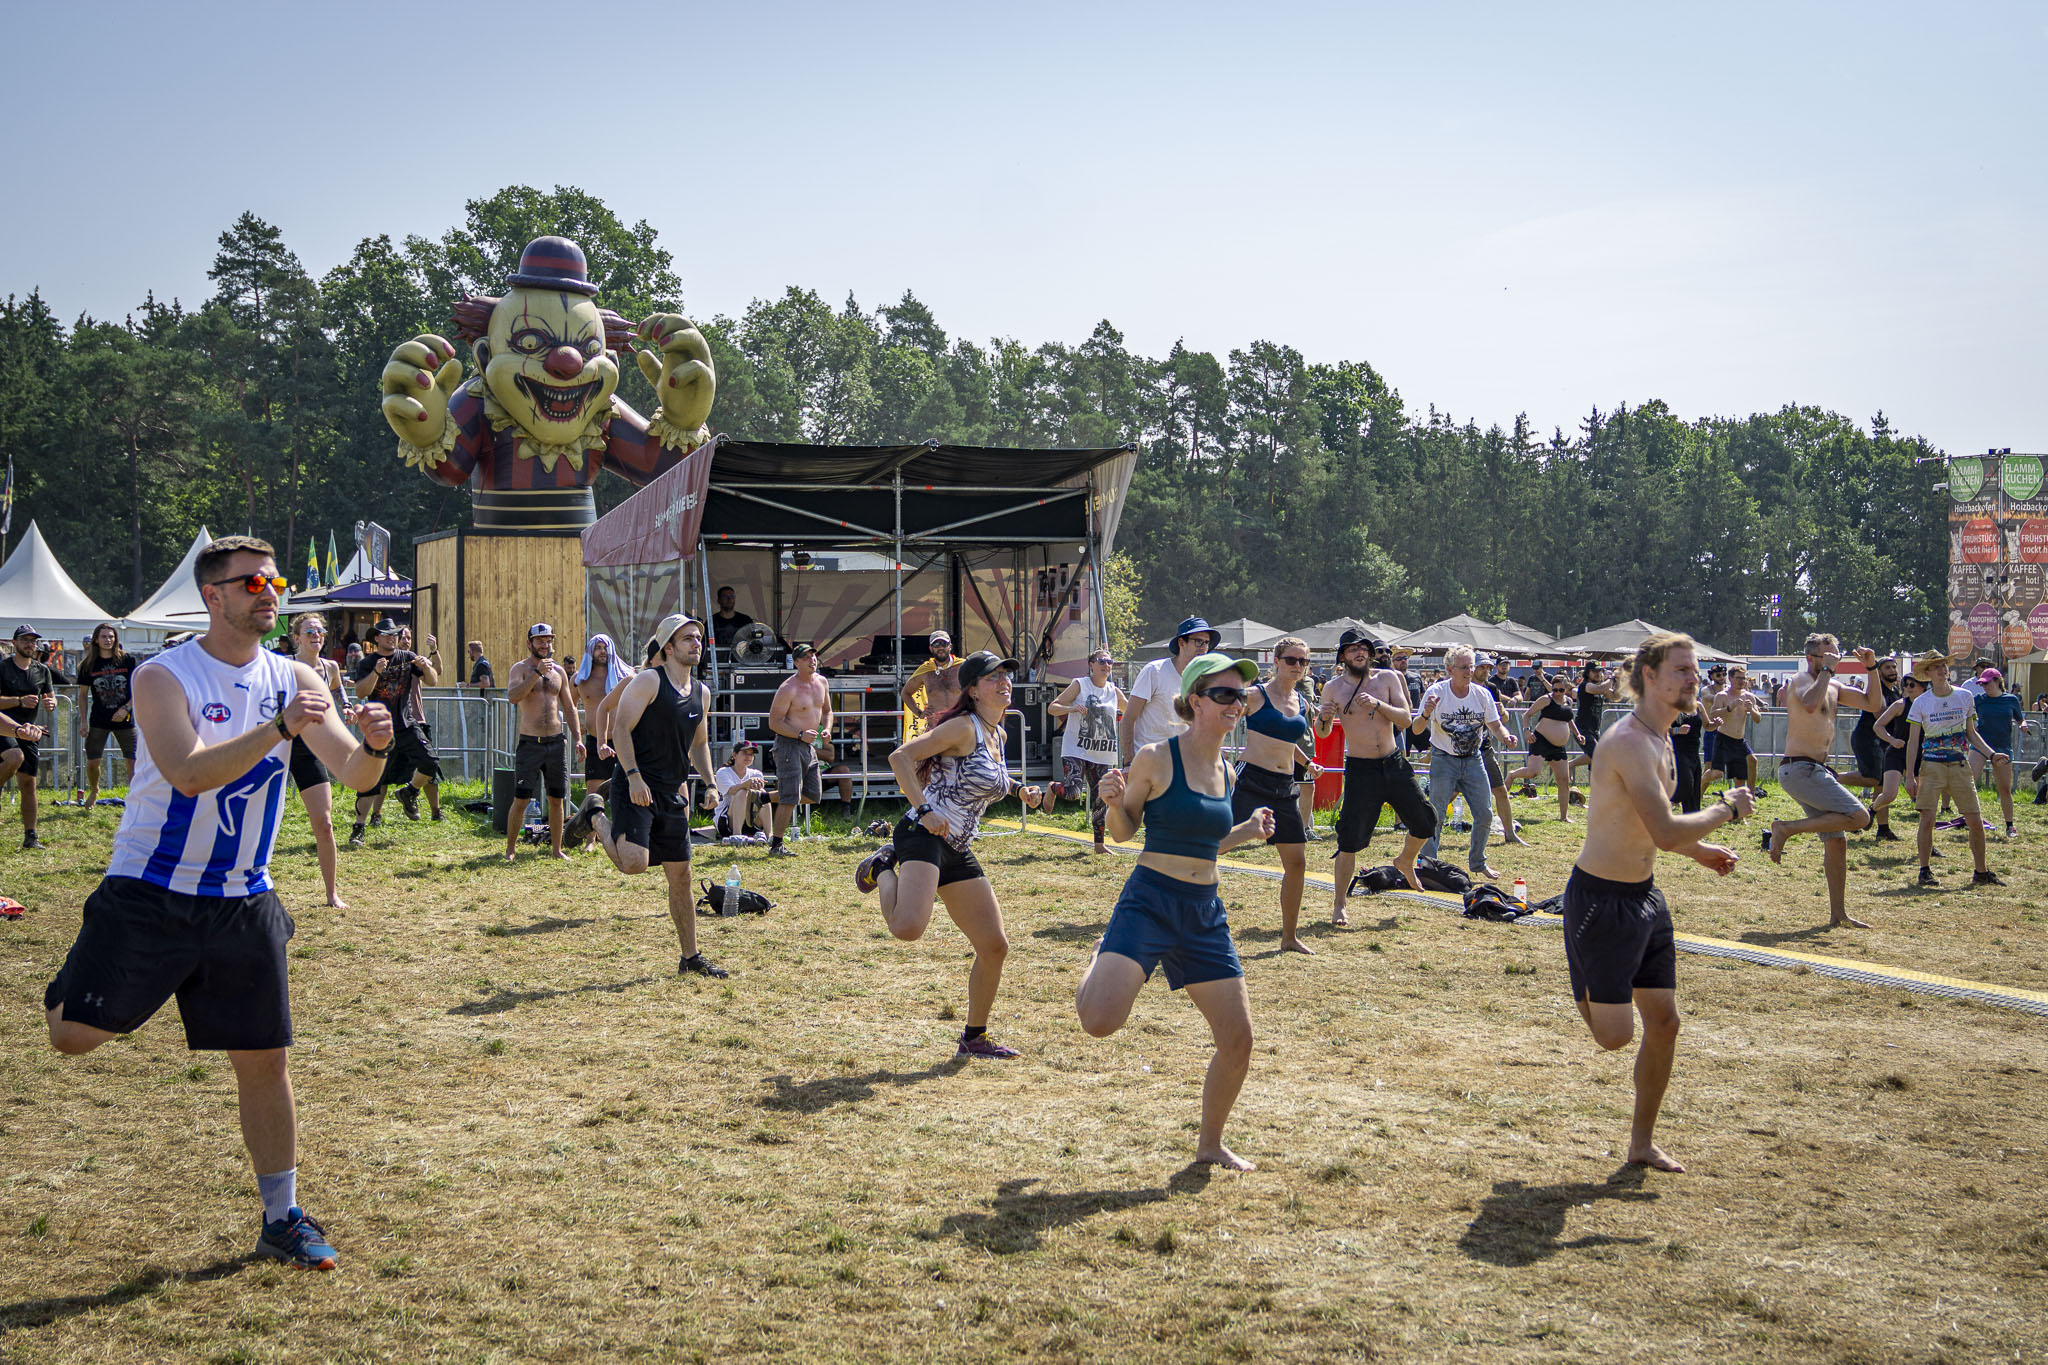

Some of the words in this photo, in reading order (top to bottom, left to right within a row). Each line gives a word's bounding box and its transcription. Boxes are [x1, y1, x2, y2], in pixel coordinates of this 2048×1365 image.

[2005, 464, 2039, 473] FLAMM-
[1951, 475, 1980, 486] KUCHEN
[2005, 474, 2040, 484] KUCHEN
[1954, 501, 1996, 513] Holzbackofen
[1963, 532, 1997, 543] FRÜHSTÜCK
[1964, 546, 1980, 554] rockt
[2023, 545, 2041, 554] rockt
[1952, 564, 1977, 574] KAFFEE
[2008, 564, 2037, 574] KAFFEE
[1966, 576, 1979, 584] hot!
[2025, 576, 2040, 584] hot!
[205, 706, 229, 719] AFL
[1077, 736, 1117, 752] ZOMBIE
